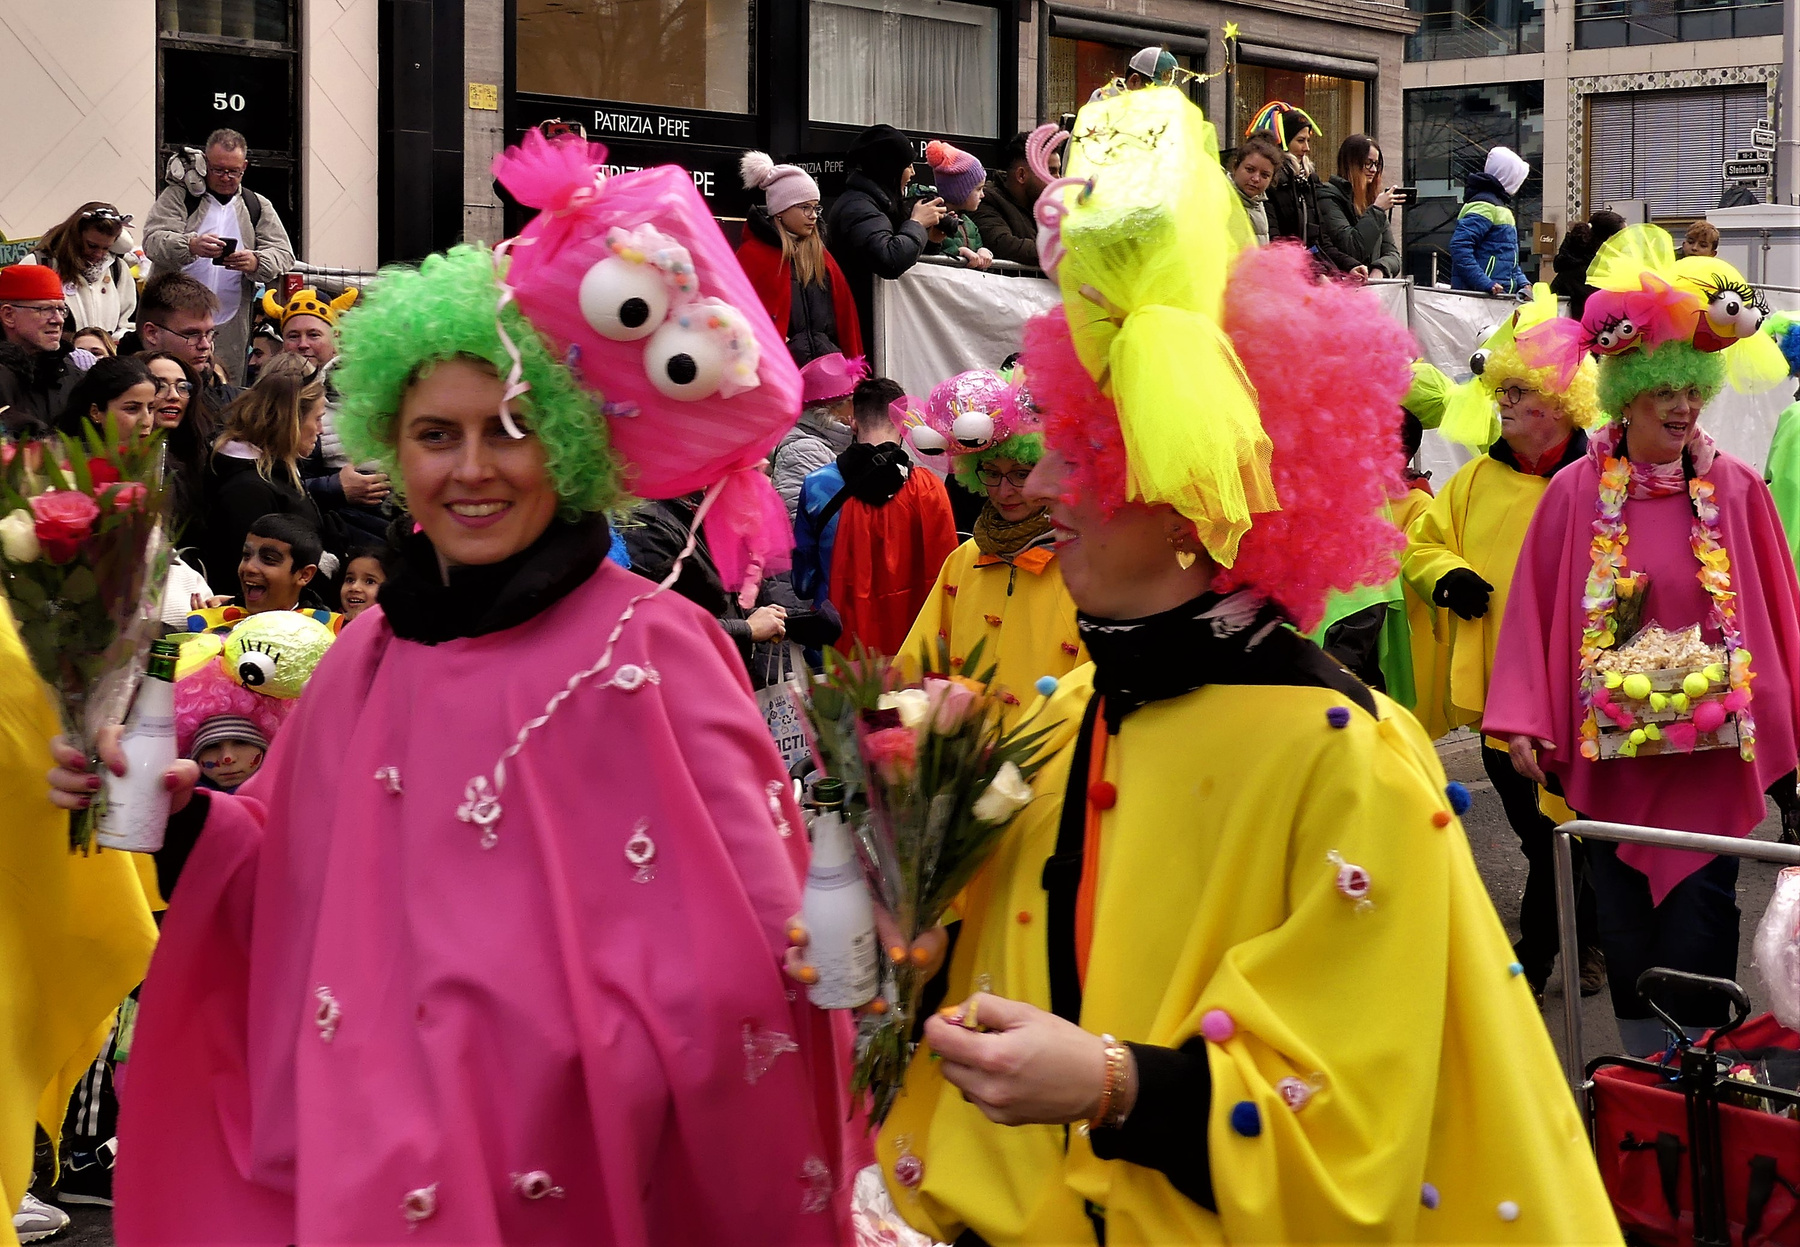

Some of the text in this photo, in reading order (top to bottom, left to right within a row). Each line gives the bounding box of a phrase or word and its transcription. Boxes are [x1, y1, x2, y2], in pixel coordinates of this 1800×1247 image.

[213, 92, 246, 112] 50
[594, 110, 690, 137] PATRIZIA PEPE
[824, 160, 844, 173] PEPE
[1729, 165, 1765, 174] Steinstraße
[688, 170, 715, 197] PE
